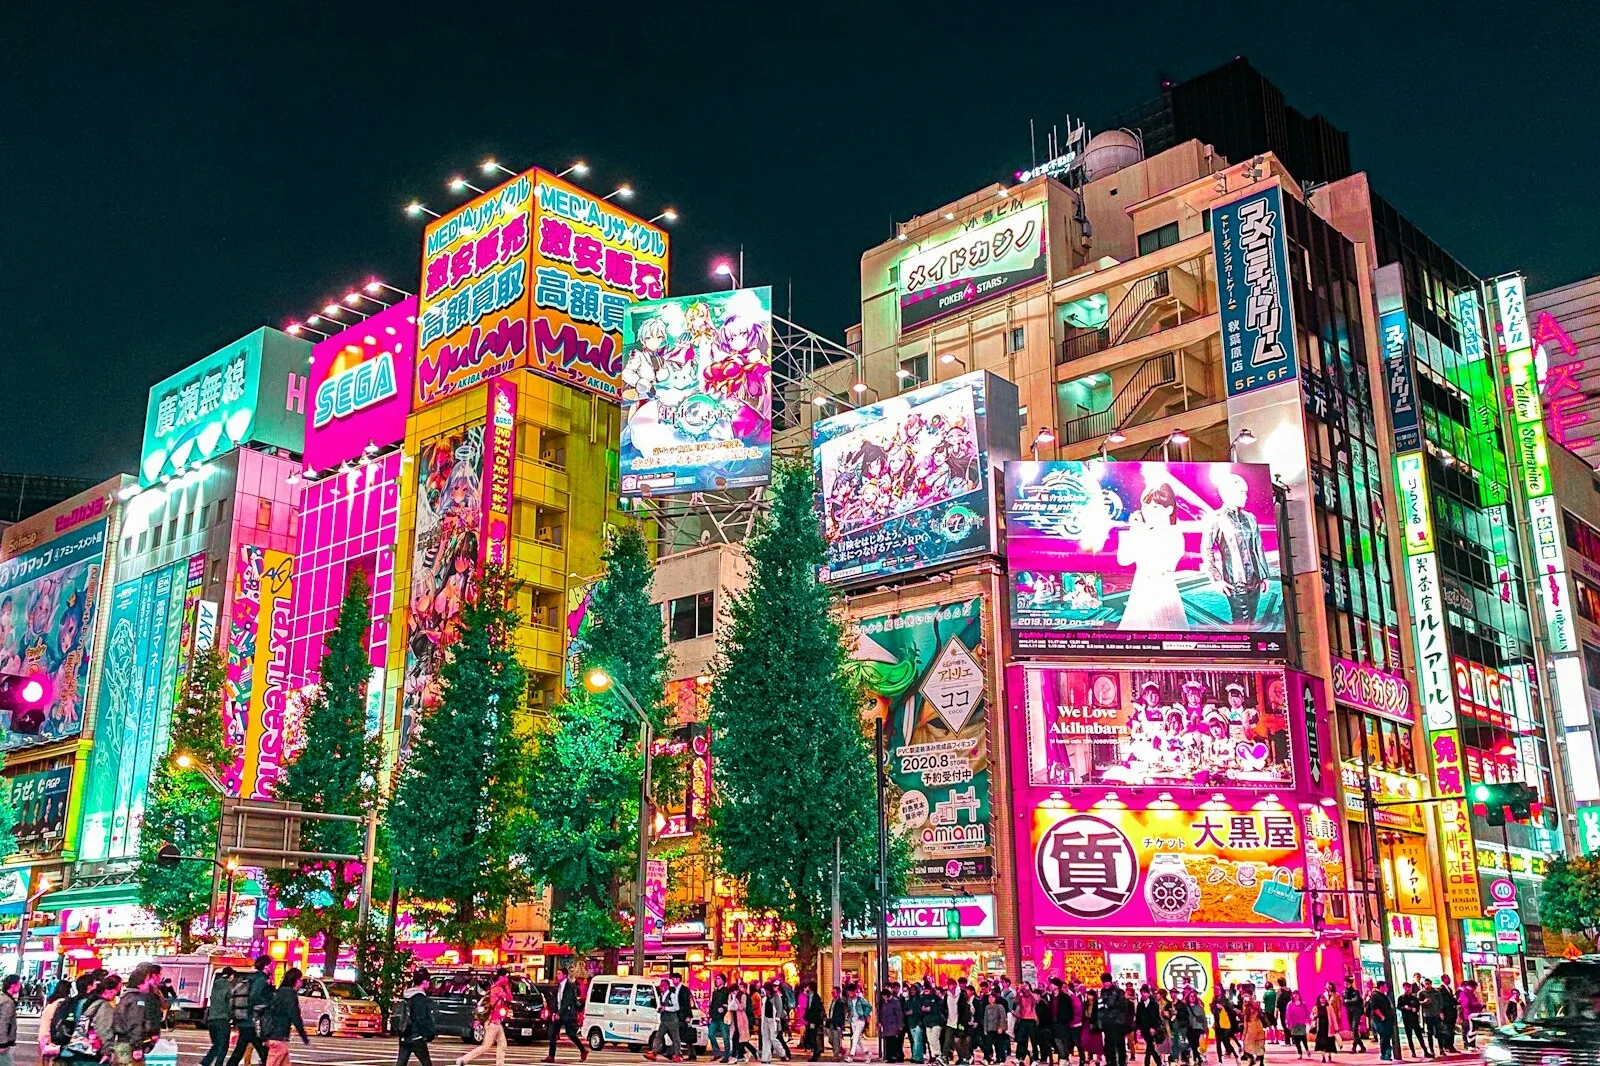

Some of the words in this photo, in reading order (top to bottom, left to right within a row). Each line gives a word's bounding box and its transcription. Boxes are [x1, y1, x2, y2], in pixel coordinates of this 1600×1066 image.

[424, 212, 529, 300] 激安販売
[539, 217, 664, 300] 激安販売
[907, 220, 1035, 291] メイドカジノ
[1222, 220, 1236, 306] トレーディングカードゲーム
[939, 291, 963, 308] POKER
[1239, 197, 1287, 367] アメニティードリーム
[420, 259, 525, 349] 高額買取
[418, 317, 527, 401] Mulan
[1228, 319, 1243, 373] 秋葉原店
[314, 352, 397, 428] SEGA
[426, 383, 457, 403] ムーラン
[457, 373, 480, 389] AKIBA
[546, 360, 587, 384] ムーラン
[587, 376, 616, 396] AKIBA
[155, 357, 245, 438] 廣瀬無線
[1515, 381, 1529, 419] Yellow
[1522, 428, 1540, 490] Submarine
[1408, 477, 1422, 525] りらくる
[12, 548, 53, 579] ソフマップ
[1018, 618, 1067, 626] 2019.10.30
[141, 600, 166, 753] 電子マネー使えます
[937, 667, 973, 682] アトリエ
[1333, 663, 1409, 715] メイドカジノ
[941, 690, 969, 709] ココ
[1057, 705, 1081, 719] We
[1081, 705, 1117, 719] Love
[1049, 722, 1128, 735] Akihabara
[903, 754, 949, 771] 2020.8
[923, 769, 972, 785] 予約受付中
[1432, 735, 1463, 795] 免税
[922, 824, 984, 842] amiami
[1191, 816, 1297, 849] 大黒屋
[1455, 799, 1467, 833] TAX
[1143, 838, 1186, 849] チケット
[1458, 839, 1475, 884] FREE
[928, 865, 944, 874] more
[1050, 831, 1126, 904] 質
[1407, 856, 1422, 905] ルノアール
[1497, 886, 1510, 895] 40
[1501, 914, 1510, 928] P
[505, 935, 539, 949] ラーメン
